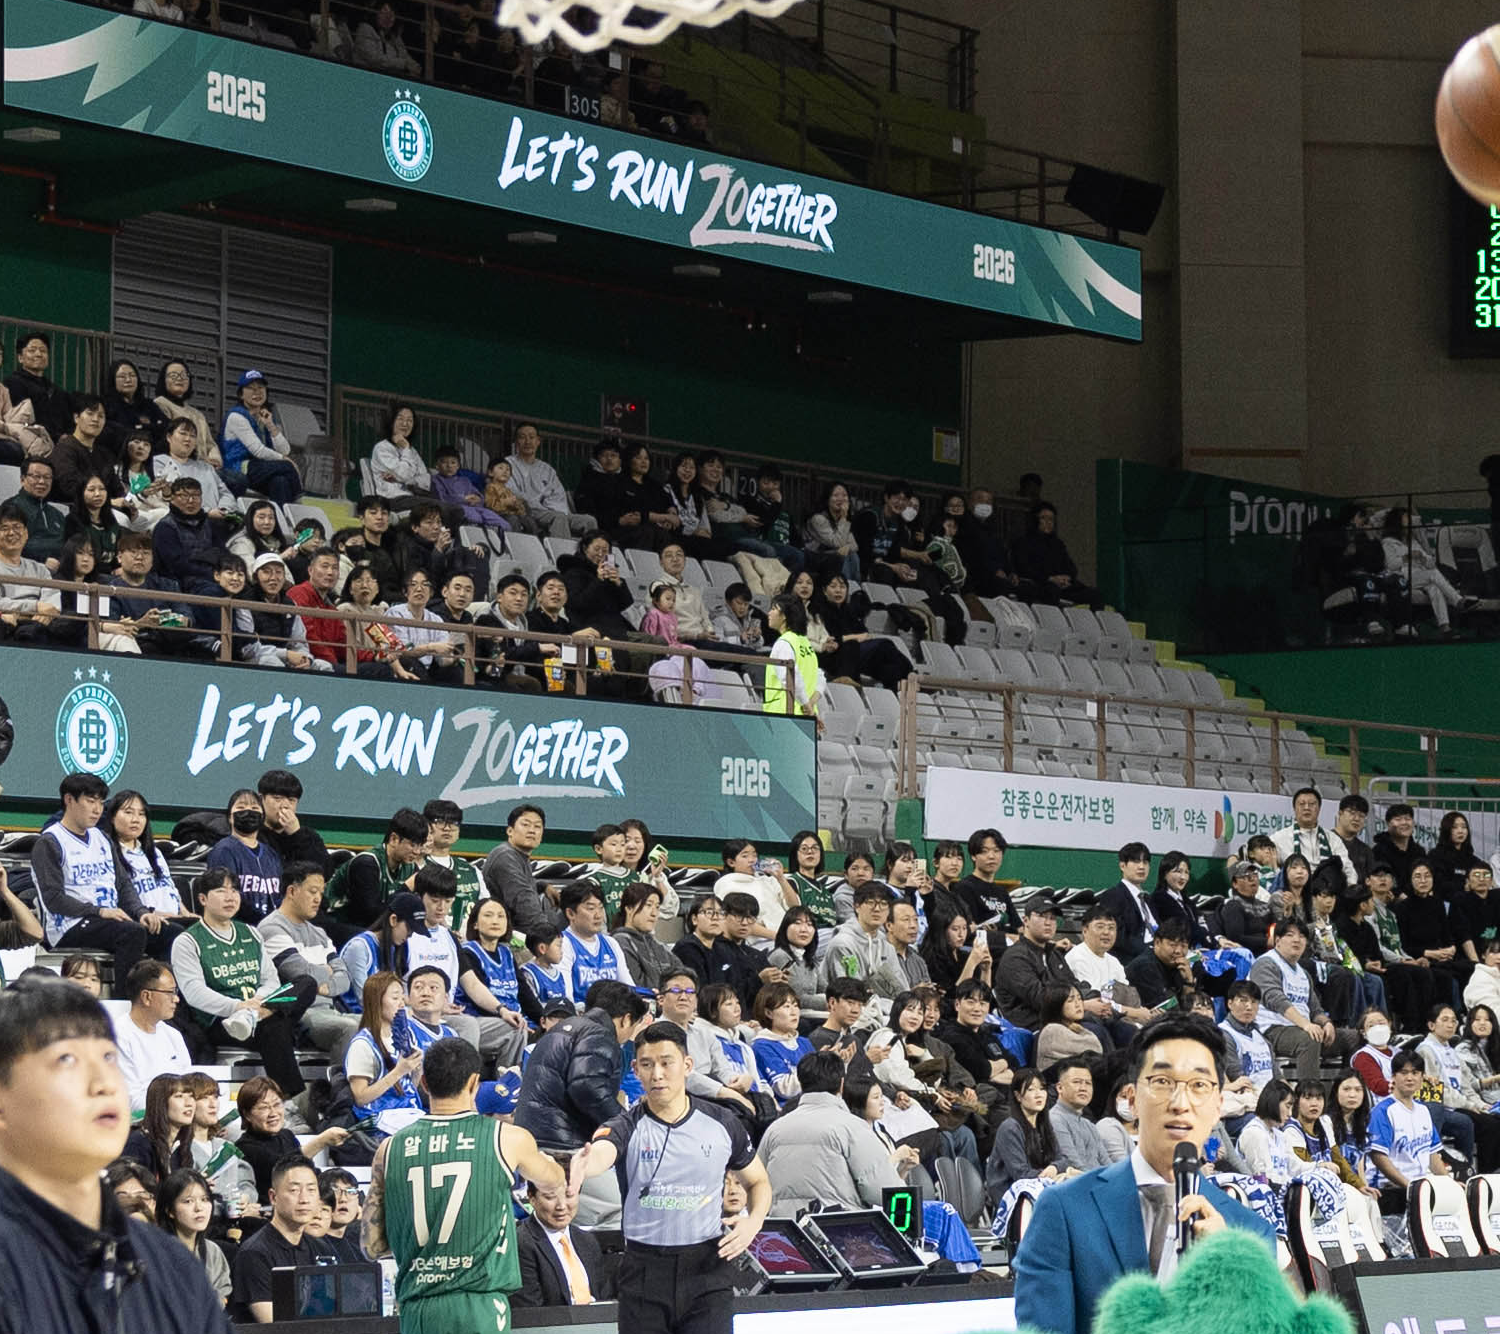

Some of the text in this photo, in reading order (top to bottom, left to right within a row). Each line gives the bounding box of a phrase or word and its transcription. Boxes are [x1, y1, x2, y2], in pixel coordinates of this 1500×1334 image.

[206, 69, 267, 124] 2025
[570, 94, 600, 119] 305
[497, 115, 600, 193] LET'S
[606, 149, 695, 216] RUN
[972, 243, 1017, 287] 2026
[185, 682, 322, 778] LET'S
[333, 703, 445, 780] RUN
[719, 755, 771, 798] 2026
[1000, 787, 1116, 827] 참좋은운전자보험
[403, 1131, 477, 1158] 알바노
[406, 1161, 472, 1249] 17
